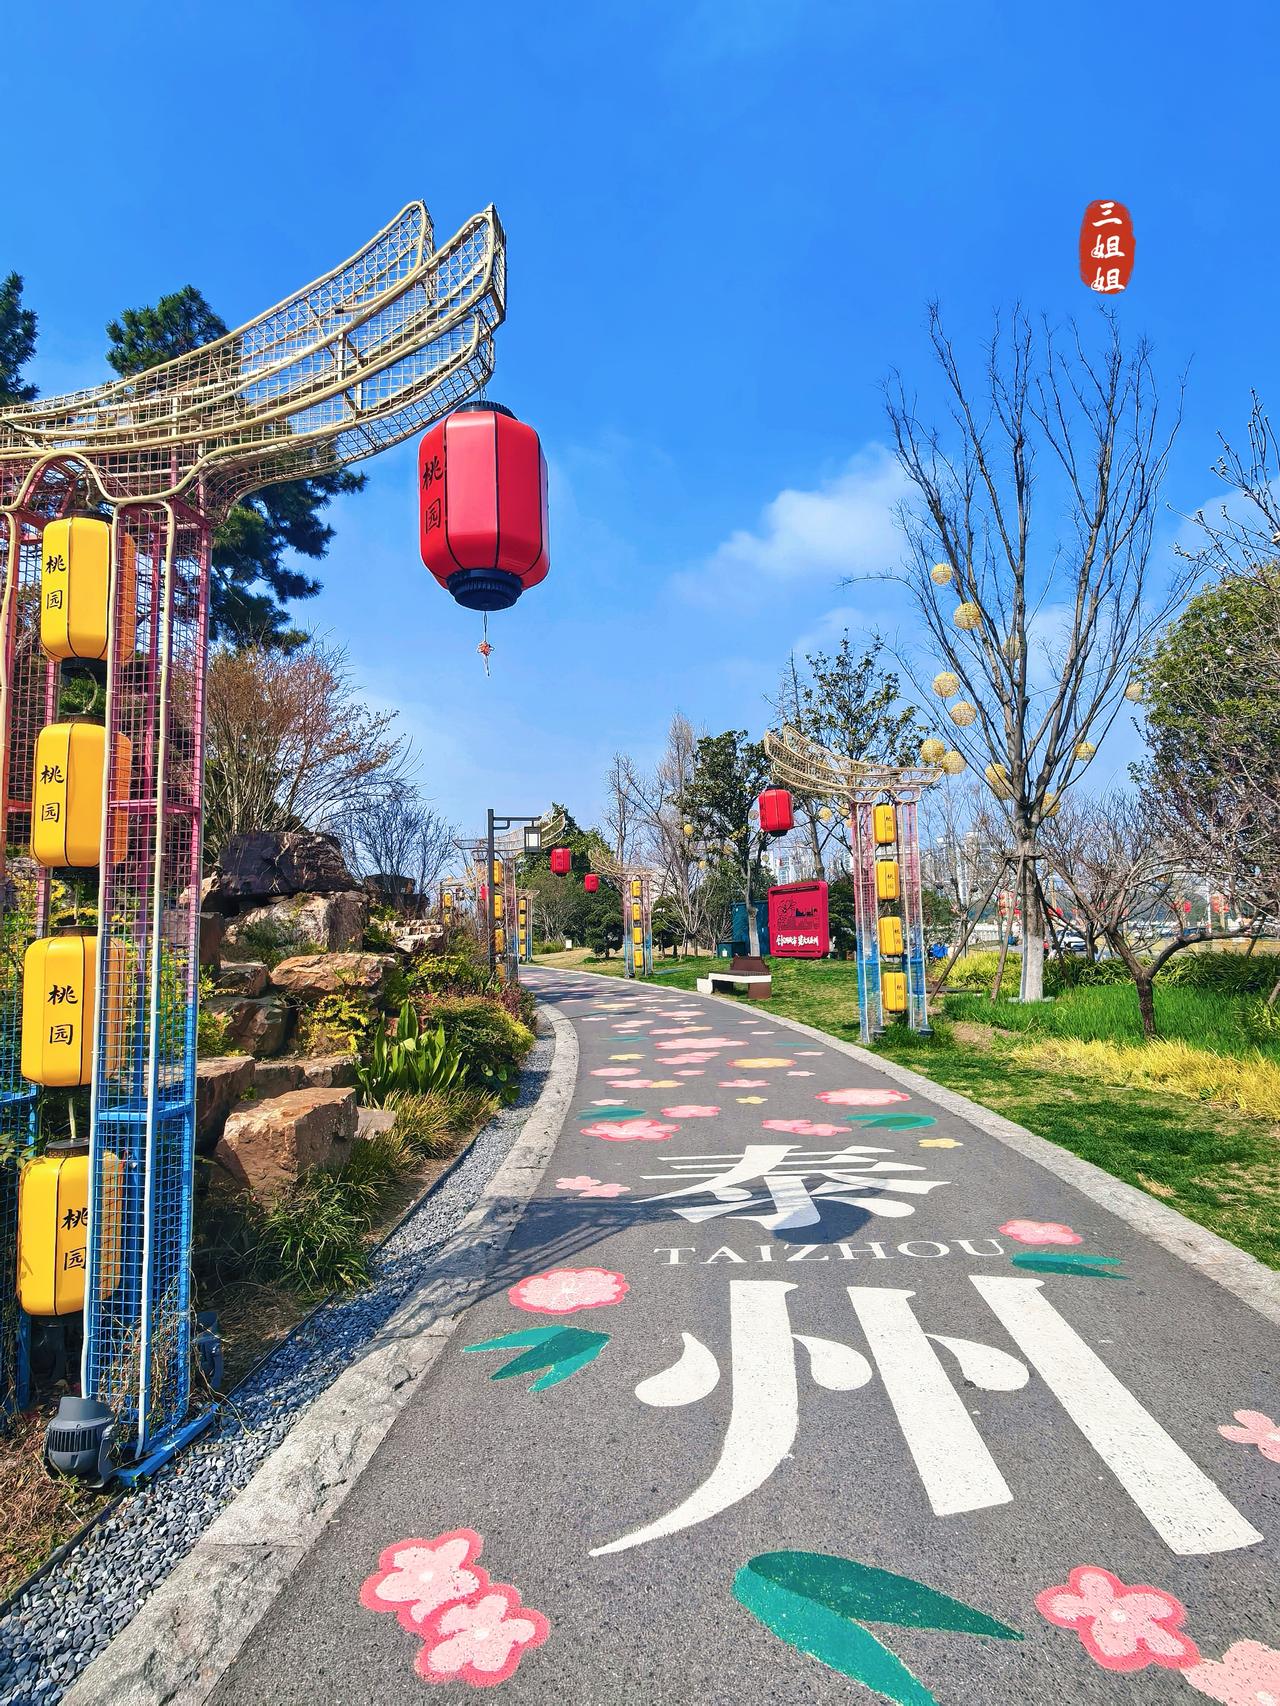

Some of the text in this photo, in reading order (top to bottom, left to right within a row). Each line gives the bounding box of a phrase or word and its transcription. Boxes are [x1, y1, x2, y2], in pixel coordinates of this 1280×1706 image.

[422, 455, 444, 535] 桃园
[45, 554, 67, 610] 桃园
[40, 764, 65, 823] 桃园
[48, 984, 79, 1046] 桃园
[631, 1144, 952, 1231] 泰
[61, 1207, 88, 1271] 桃园
[653, 1238, 1006, 1266] TAIZHOU
[588, 1275, 1265, 1556] 州
